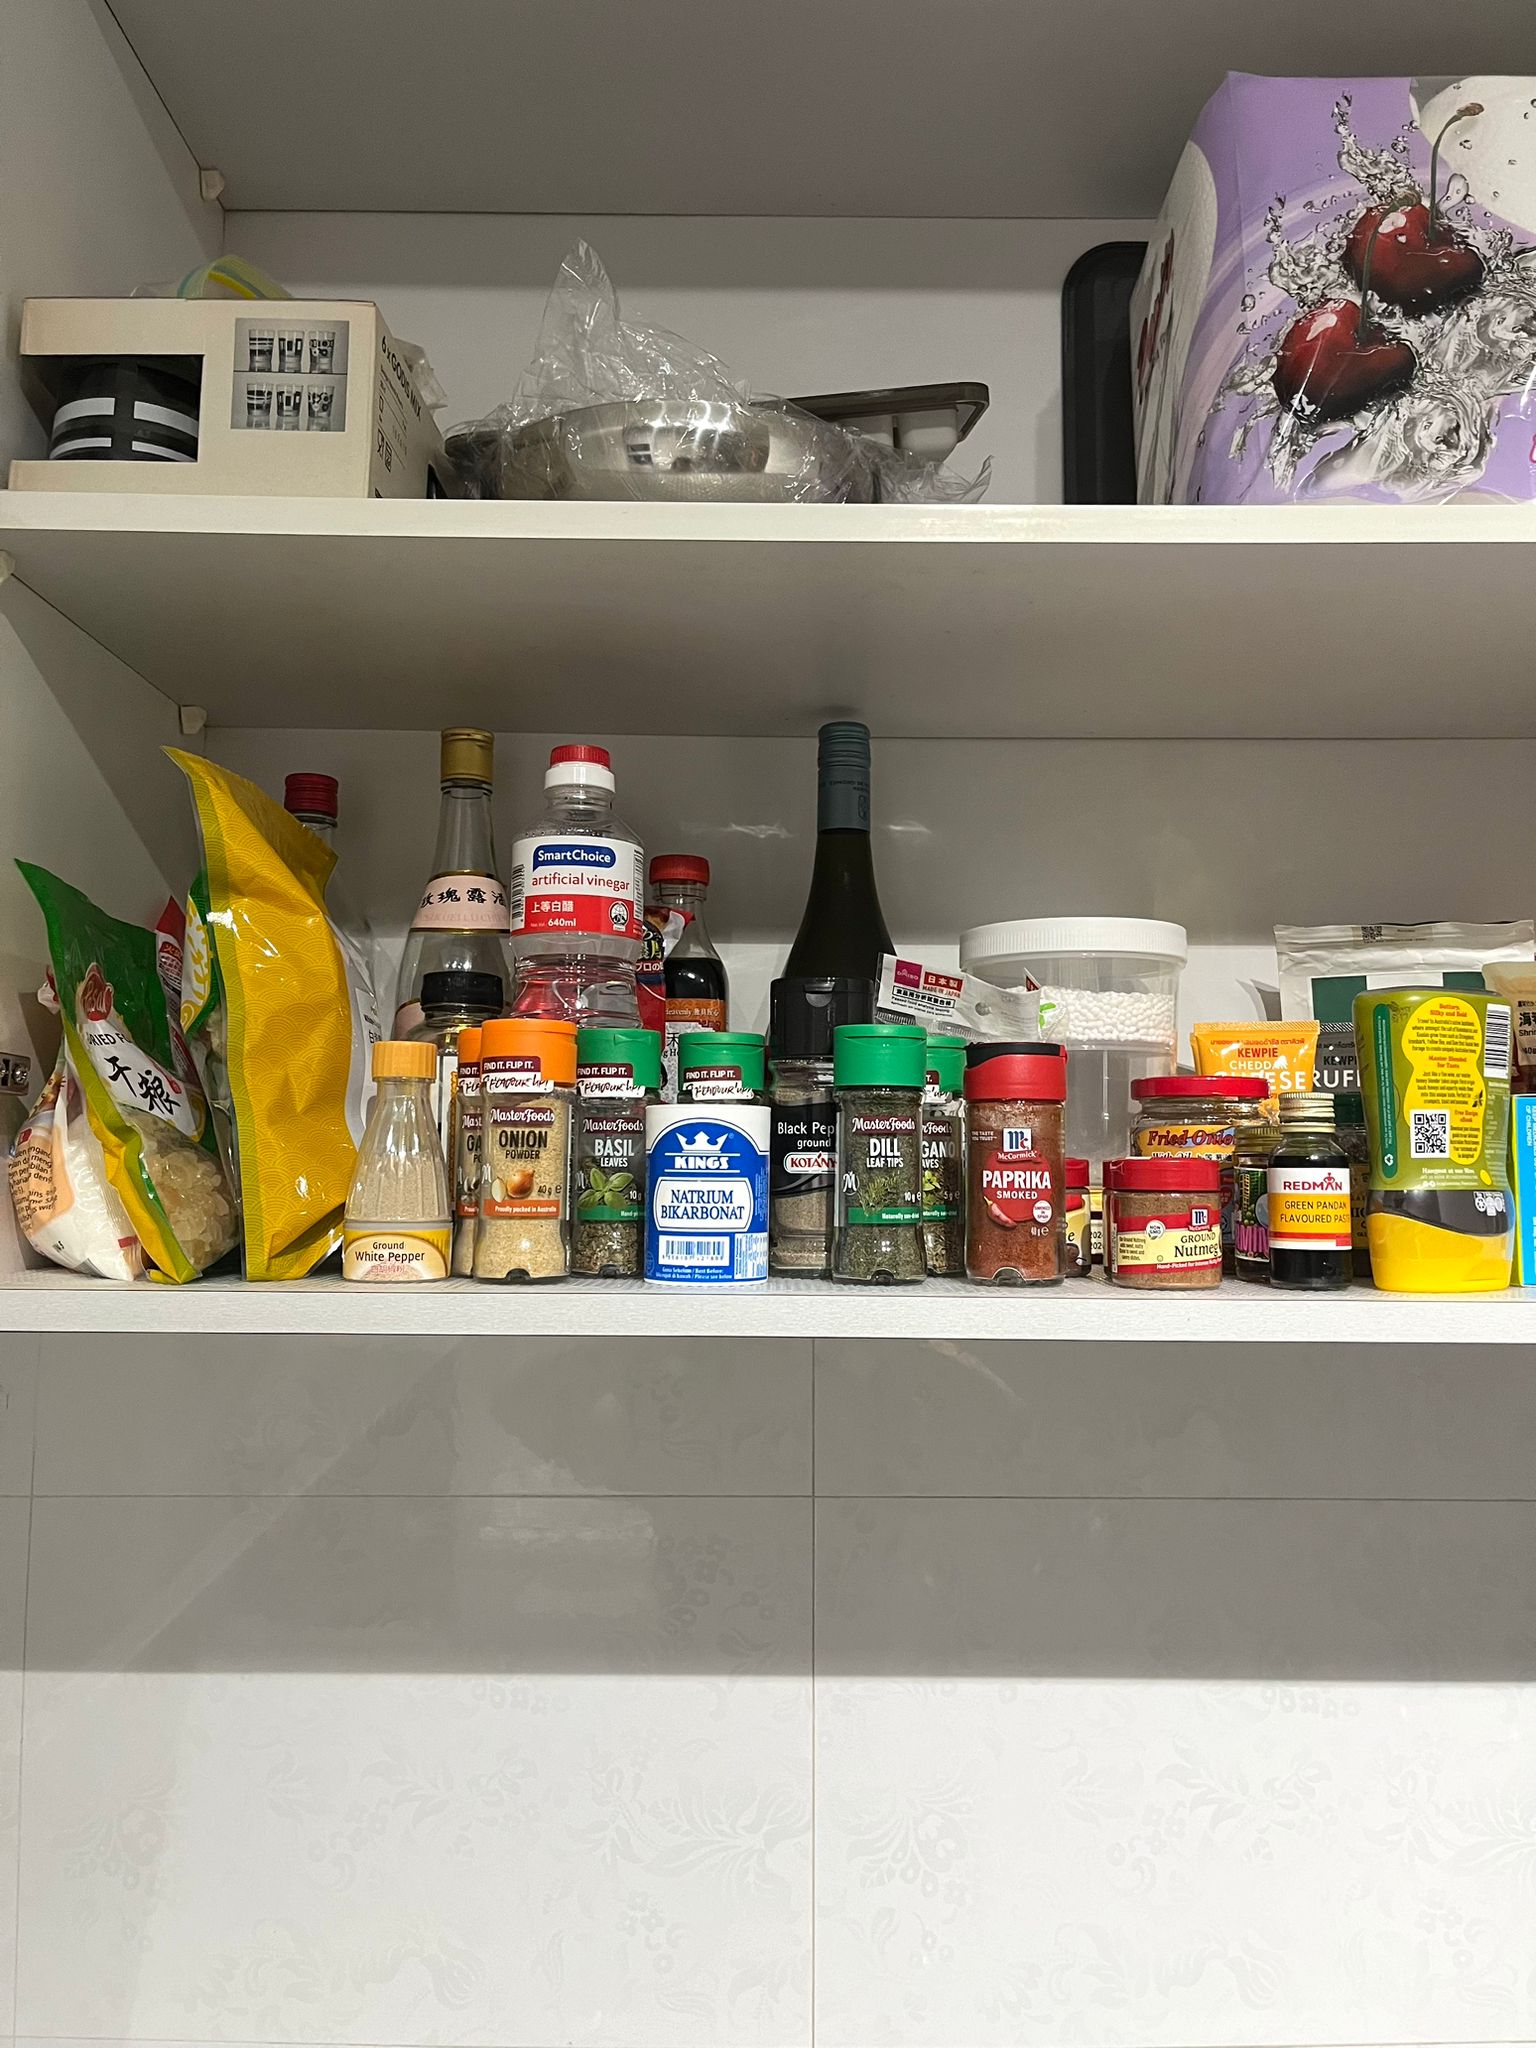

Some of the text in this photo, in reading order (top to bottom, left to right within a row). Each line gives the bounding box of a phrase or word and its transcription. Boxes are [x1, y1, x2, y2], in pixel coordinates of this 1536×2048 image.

[538, 850, 611, 863] SmartChoice
[532, 872, 630, 891] artificial vinegar
[548, 919, 576, 927] 640ml
[928, 974, 958, 988] 日本製
[1238, 1047, 1279, 1058] KEWPIE
[484, 1062, 497, 1071] FIND
[506, 1061, 523, 1069] FLIP
[601, 1067, 617, 1075] FLIP
[1229, 1060, 1288, 1071] CHEDD
[710, 1070, 726, 1078] FLIP
[491, 1108, 555, 1123] MasterFoods
[583, 1119, 644, 1132] MasterFoods
[778, 1121, 835, 1137] Black Pep
[852, 1116, 915, 1132] MasterFoods
[499, 1130, 547, 1148] ONION
[797, 1138, 832, 1150] ground
[1147, 1130, 1189, 1146] Fried
[595, 1139, 635, 1157] BASIL
[869, 1138, 901, 1157] DILL
[505, 1150, 541, 1160] POWDER
[601, 1157, 628, 1168] LEAVES
[675, 1157, 729, 1169] KINGS
[867, 1158, 904, 1168] LEAF TIPS
[982, 1170, 1052, 1189] PAPRIKA
[1283, 1178, 1343, 1191] REDMAN
[671, 1190, 734, 1204] NATRIUM
[997, 1191, 1038, 1199] SMOKED
[1285, 1200, 1347, 1210] GREEN PANDAN
[661, 1206, 745, 1220] BIKARBONAT
[1280, 1213, 1332, 1223] FLAVOURED
[1181, 1232, 1216, 1243] GROUND
[372, 1241, 405, 1250] Ground
[1174, 1243, 1219, 1258] Nutmeg
[355, 1251, 426, 1264] White Pepper
